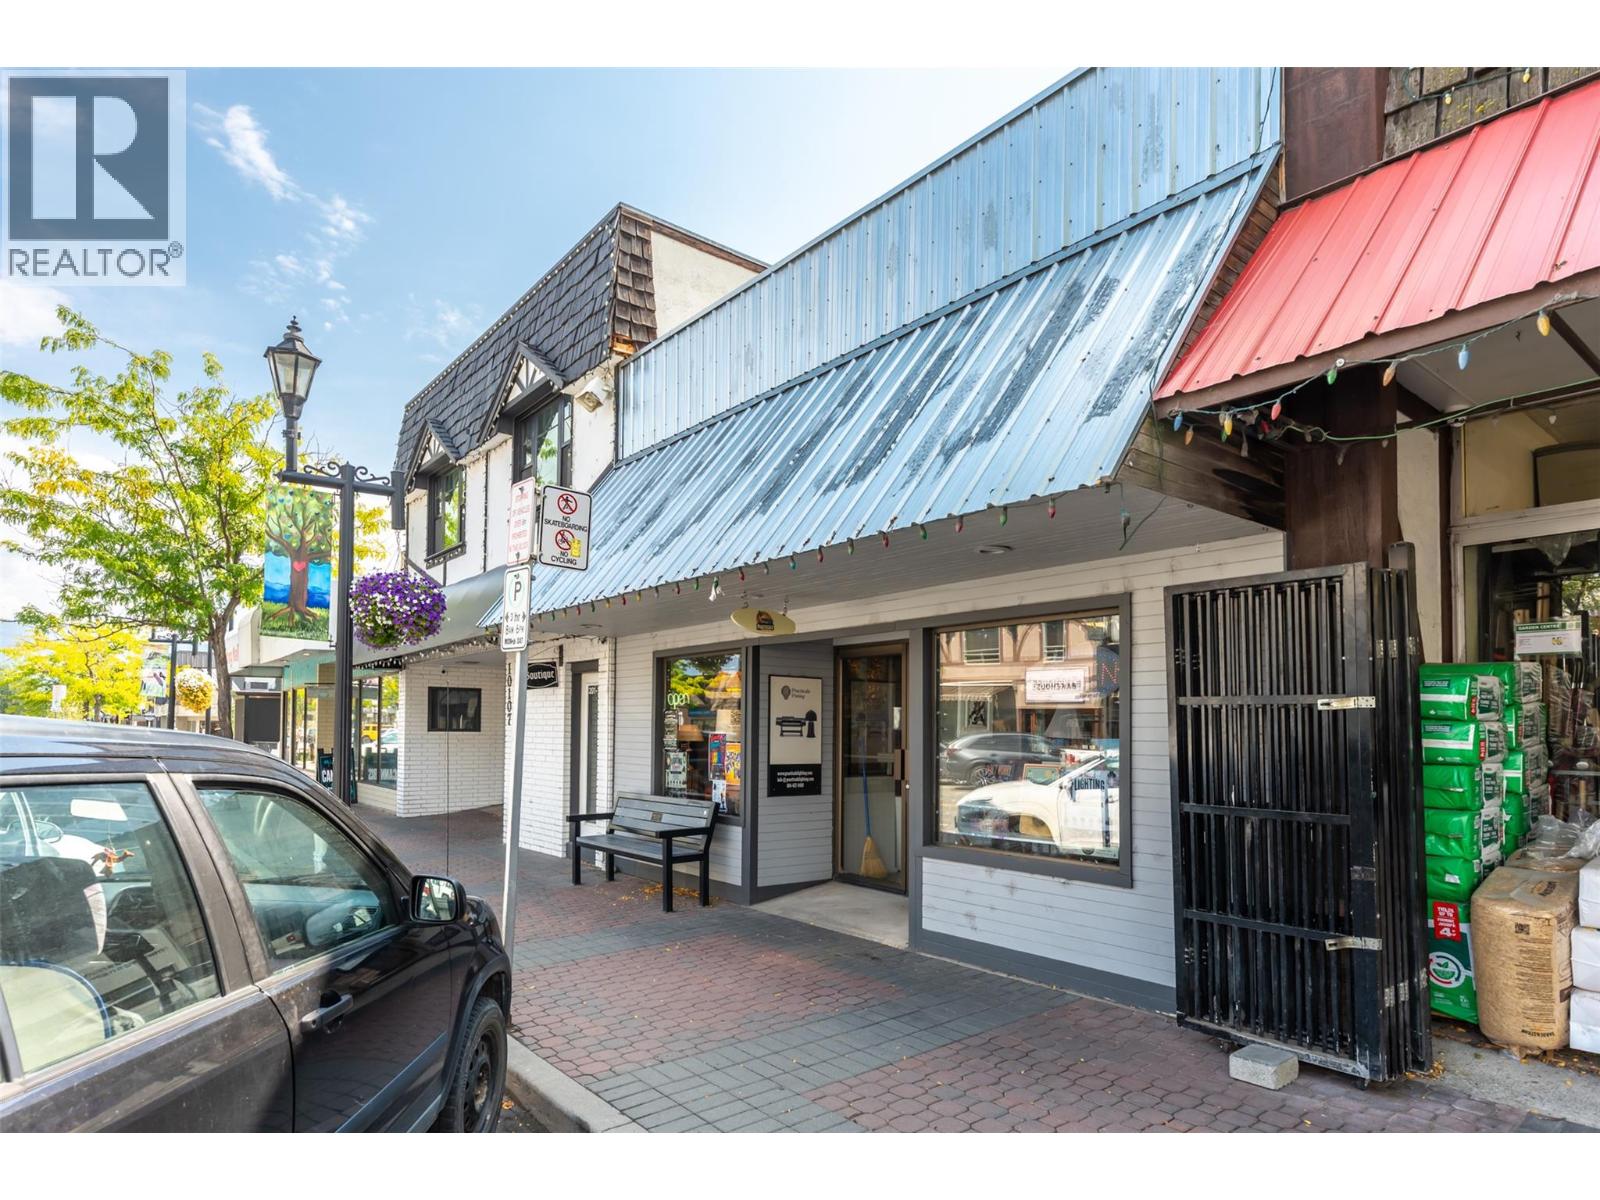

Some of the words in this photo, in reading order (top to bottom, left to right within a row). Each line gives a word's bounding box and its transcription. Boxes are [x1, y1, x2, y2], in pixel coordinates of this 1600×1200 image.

[544, 518, 588, 533] SKATEBOARDING
[551, 555, 577, 566] CYCLING
[514, 581, 522, 601] P
[667, 690, 690, 709] open
[1074, 778, 1106, 790] LIGHTING
